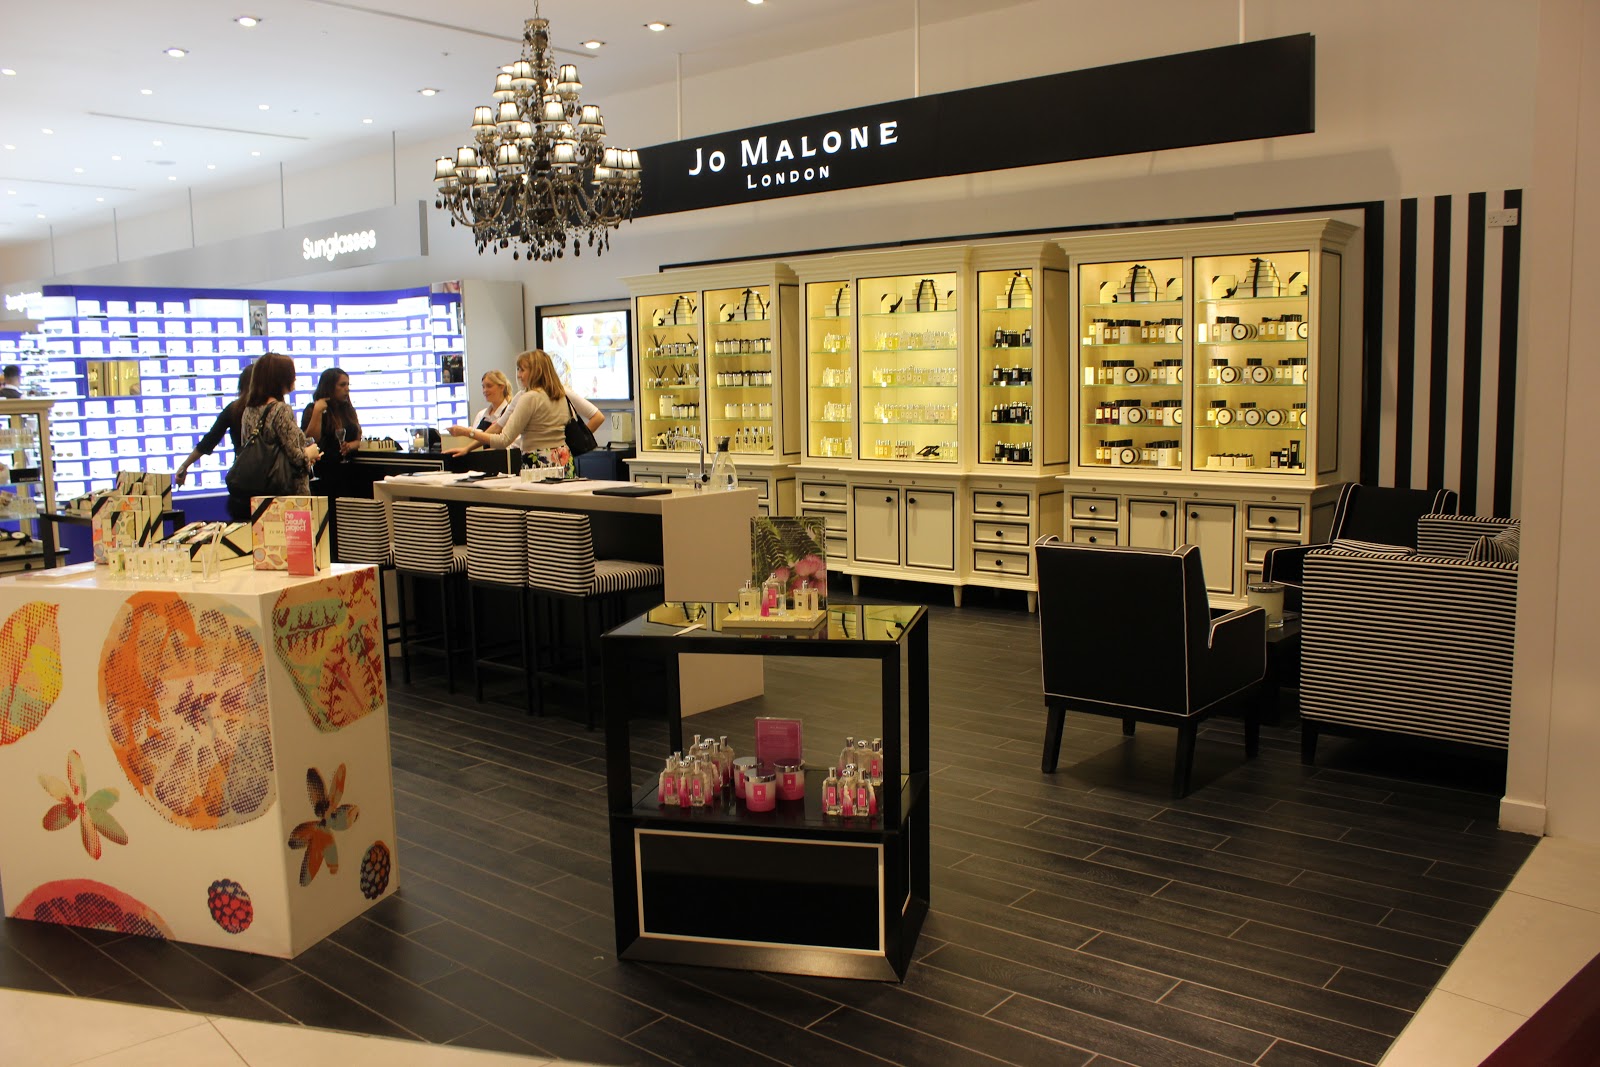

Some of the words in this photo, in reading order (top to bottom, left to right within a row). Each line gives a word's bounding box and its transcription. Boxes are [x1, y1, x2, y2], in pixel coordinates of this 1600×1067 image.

[740, 120, 898, 167] MALONE
[747, 165, 830, 189] LONDON
[302, 229, 377, 262] Sunglasses
